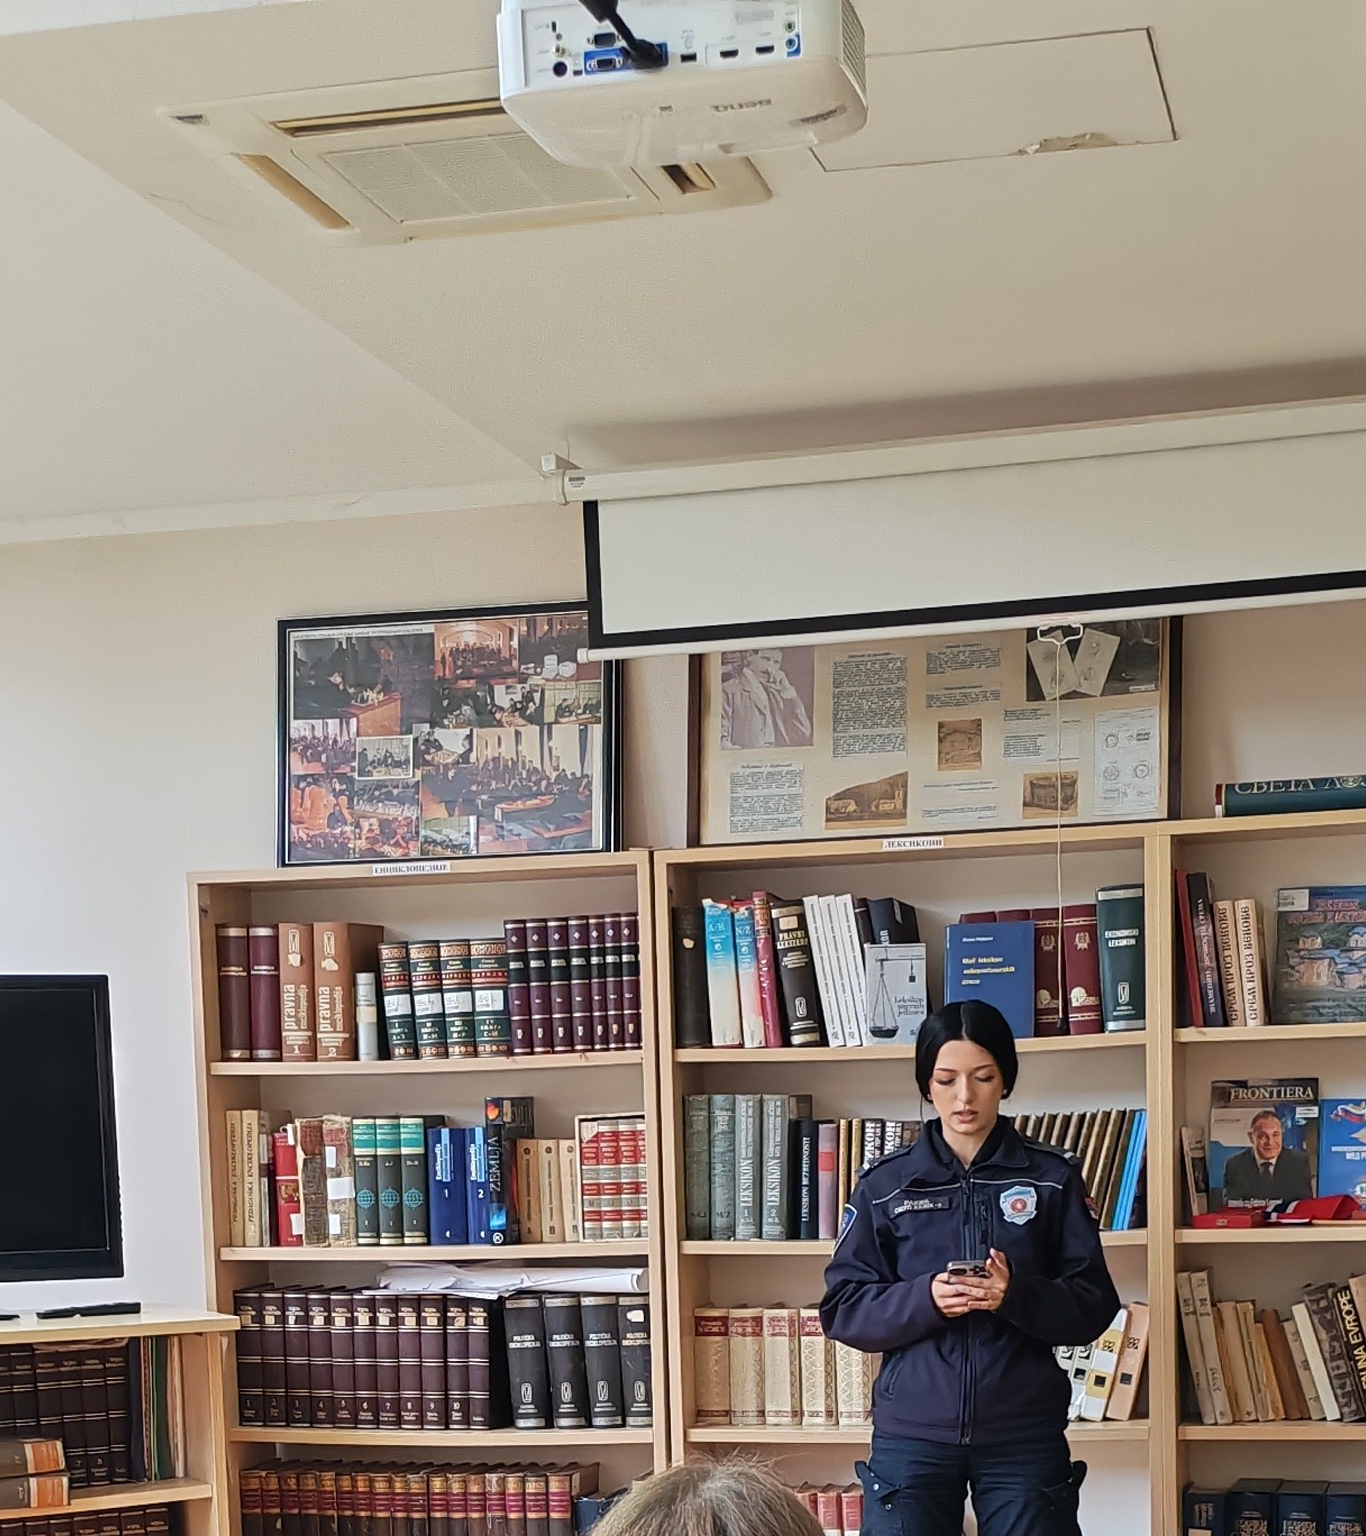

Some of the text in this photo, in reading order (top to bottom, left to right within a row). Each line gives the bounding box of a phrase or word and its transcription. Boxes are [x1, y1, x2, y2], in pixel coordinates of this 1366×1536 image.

[1234, 777, 1316, 794] СВЕТА
[884, 838, 943, 849] ЛЕКСИКОНИ
[1223, 954, 1234, 984] КРОЗ
[1245, 953, 1255, 983] КРОЗ
[282, 984, 297, 1030] pravna
[317, 986, 332, 1032] pravna
[1226, 986, 1238, 1021] СРЕМ
[1246, 986, 1258, 1020] СРЕМ
[292, 1045, 300, 1054] 1
[327, 1047, 337, 1057] 2
[1231, 1086, 1314, 1101] FRONTIERA
[864, 1123, 875, 1158] ИКОН
[883, 1121, 896, 1154] ИКОН
[489, 1135, 500, 1192] ZEMLJA
[444, 1188, 449, 1197] 1
[478, 1189, 484, 1198] 2
[739, 1159, 753, 1206] LEKSIKON
[767, 1158, 781, 1206] LEKSIKON
[743, 1209, 748, 1217] 1
[770, 1208, 777, 1217] 2
[801, 1186, 810, 1222] LEKSIKON
[1337, 1289, 1363, 1344] EVROPE
